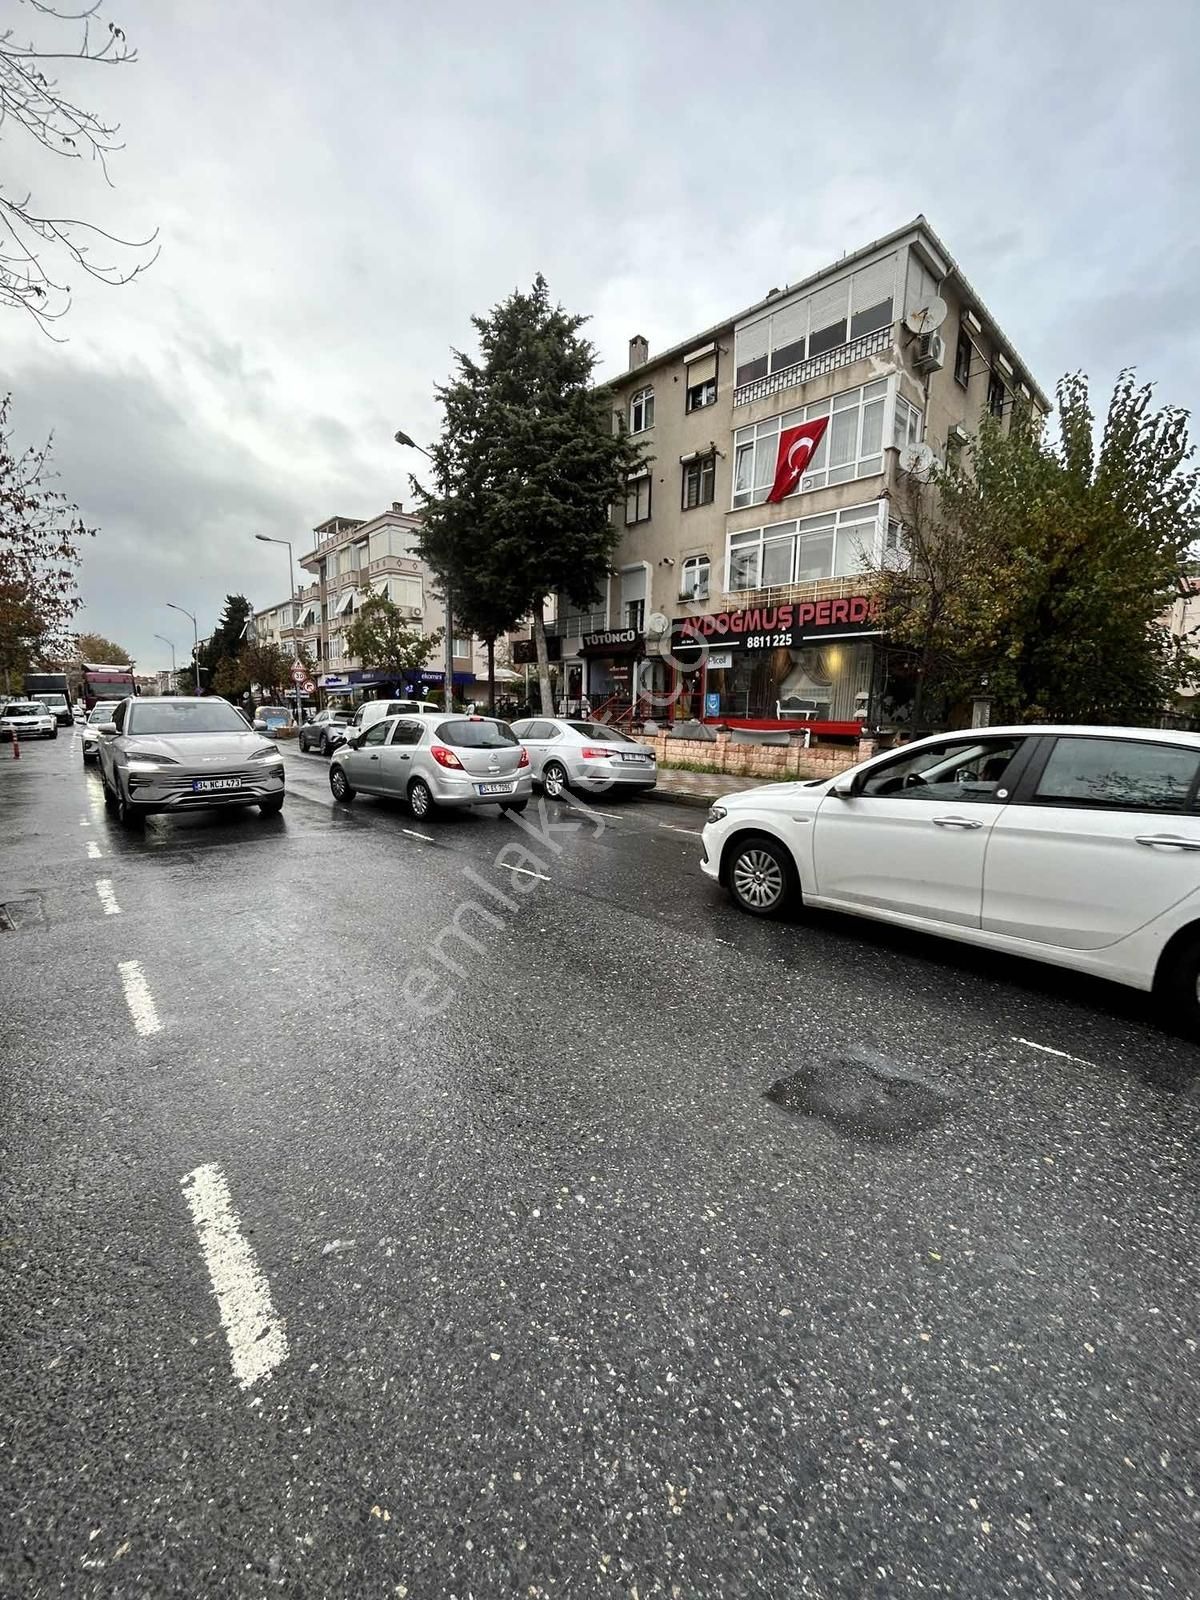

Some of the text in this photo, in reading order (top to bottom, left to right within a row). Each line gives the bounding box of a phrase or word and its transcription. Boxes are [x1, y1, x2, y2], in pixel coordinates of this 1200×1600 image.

[747, 634, 792, 649] 8811 225
[226, 778, 240, 787] 473
